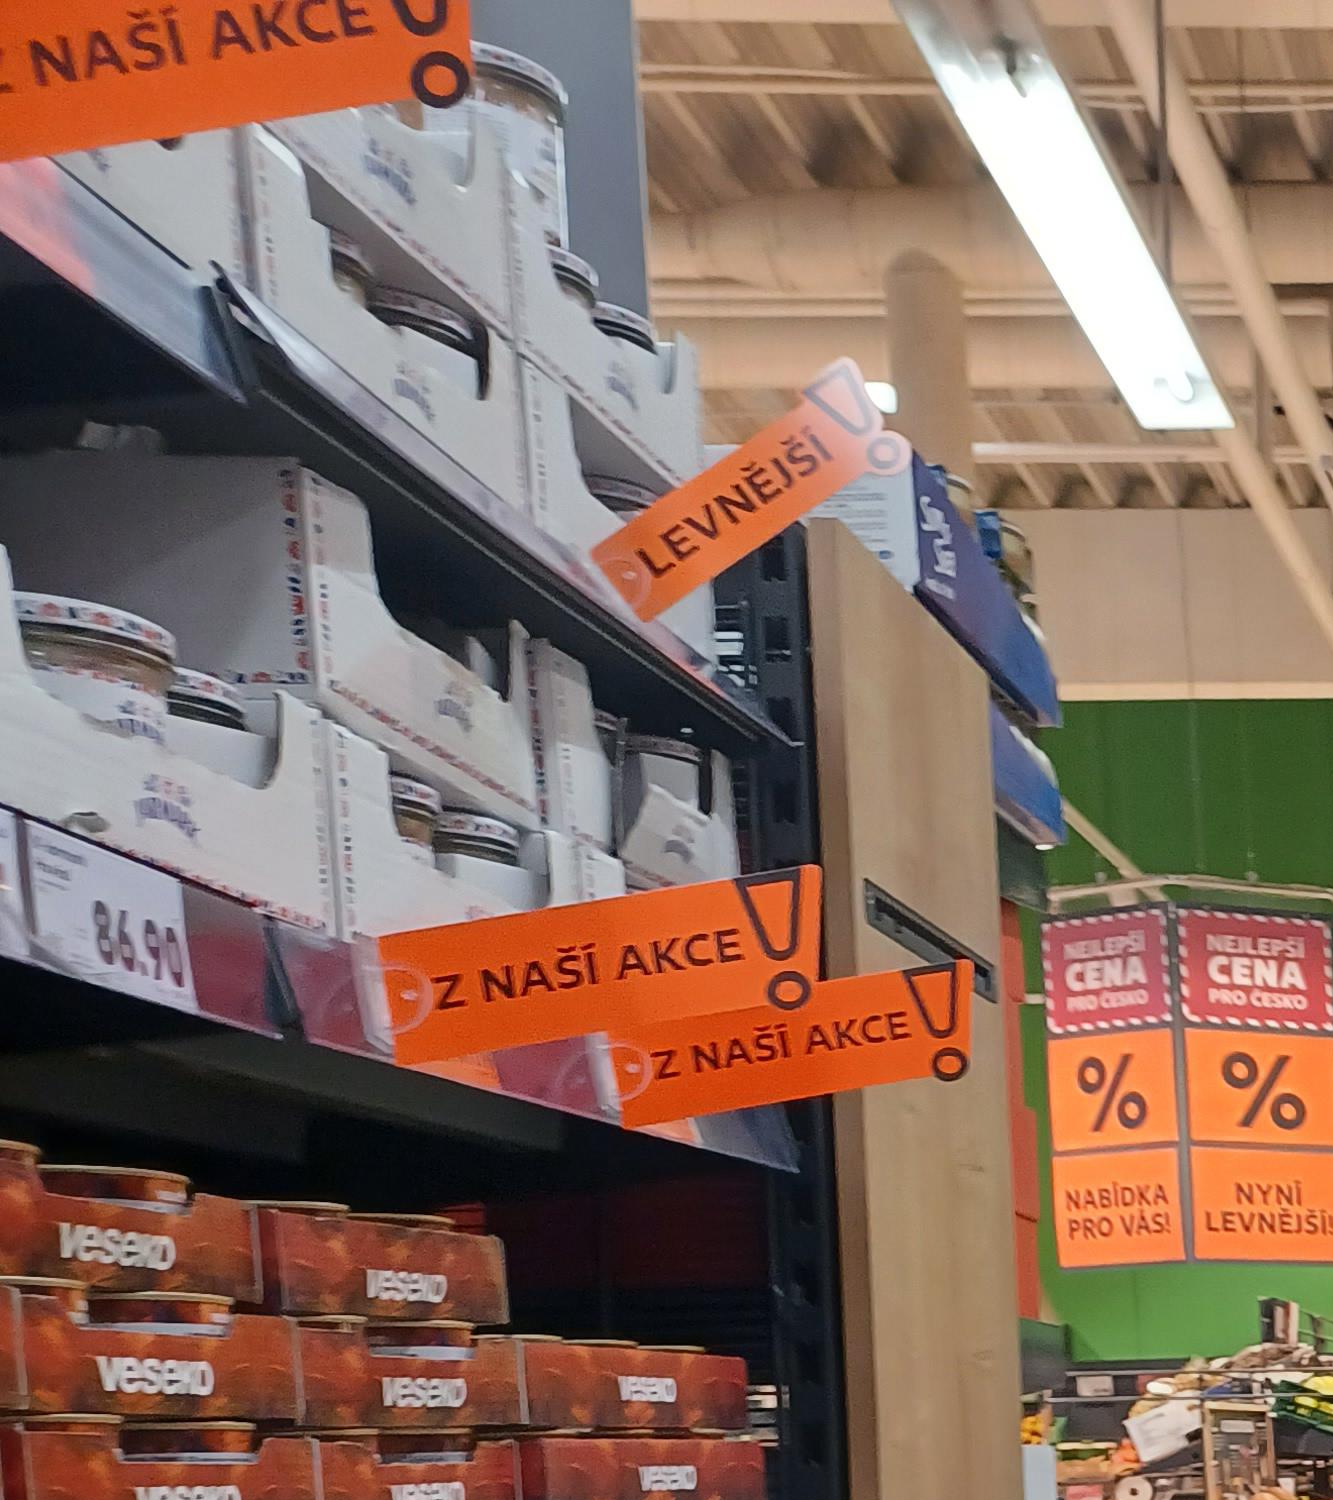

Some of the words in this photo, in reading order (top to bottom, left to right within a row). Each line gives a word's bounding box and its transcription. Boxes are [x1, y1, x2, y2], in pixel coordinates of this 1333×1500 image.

[29, 5, 188, 87] NAŠÍ
[210, 0, 377, 60] AKCE
[633, 425, 835, 580] LEVNĚJŠÍ
[1206, 933, 1305, 958] NEJLEPŠÍ
[433, 973, 468, 1011] Z
[481, 944, 599, 1004] NAŠÍ
[616, 929, 742, 983] AKCE
[1065, 956, 1148, 991] CENA
[1207, 955, 1307, 990] CENA
[1066, 994, 1098, 1011] PRO
[1208, 988, 1247, 1006] PRO
[1251, 987, 1308, 1010] ČESKO
[650, 1048, 679, 1081] Z
[693, 1023, 791, 1071] NAŠÍ
[806, 1011, 913, 1053] AKCE
[1065, 1181, 1169, 1212] NABÍDKA
[1234, 1180, 1303, 1206] NYNÍ
[1068, 1216, 1114, 1240] PRO
[1119, 1209, 1171, 1237] VÁS!
